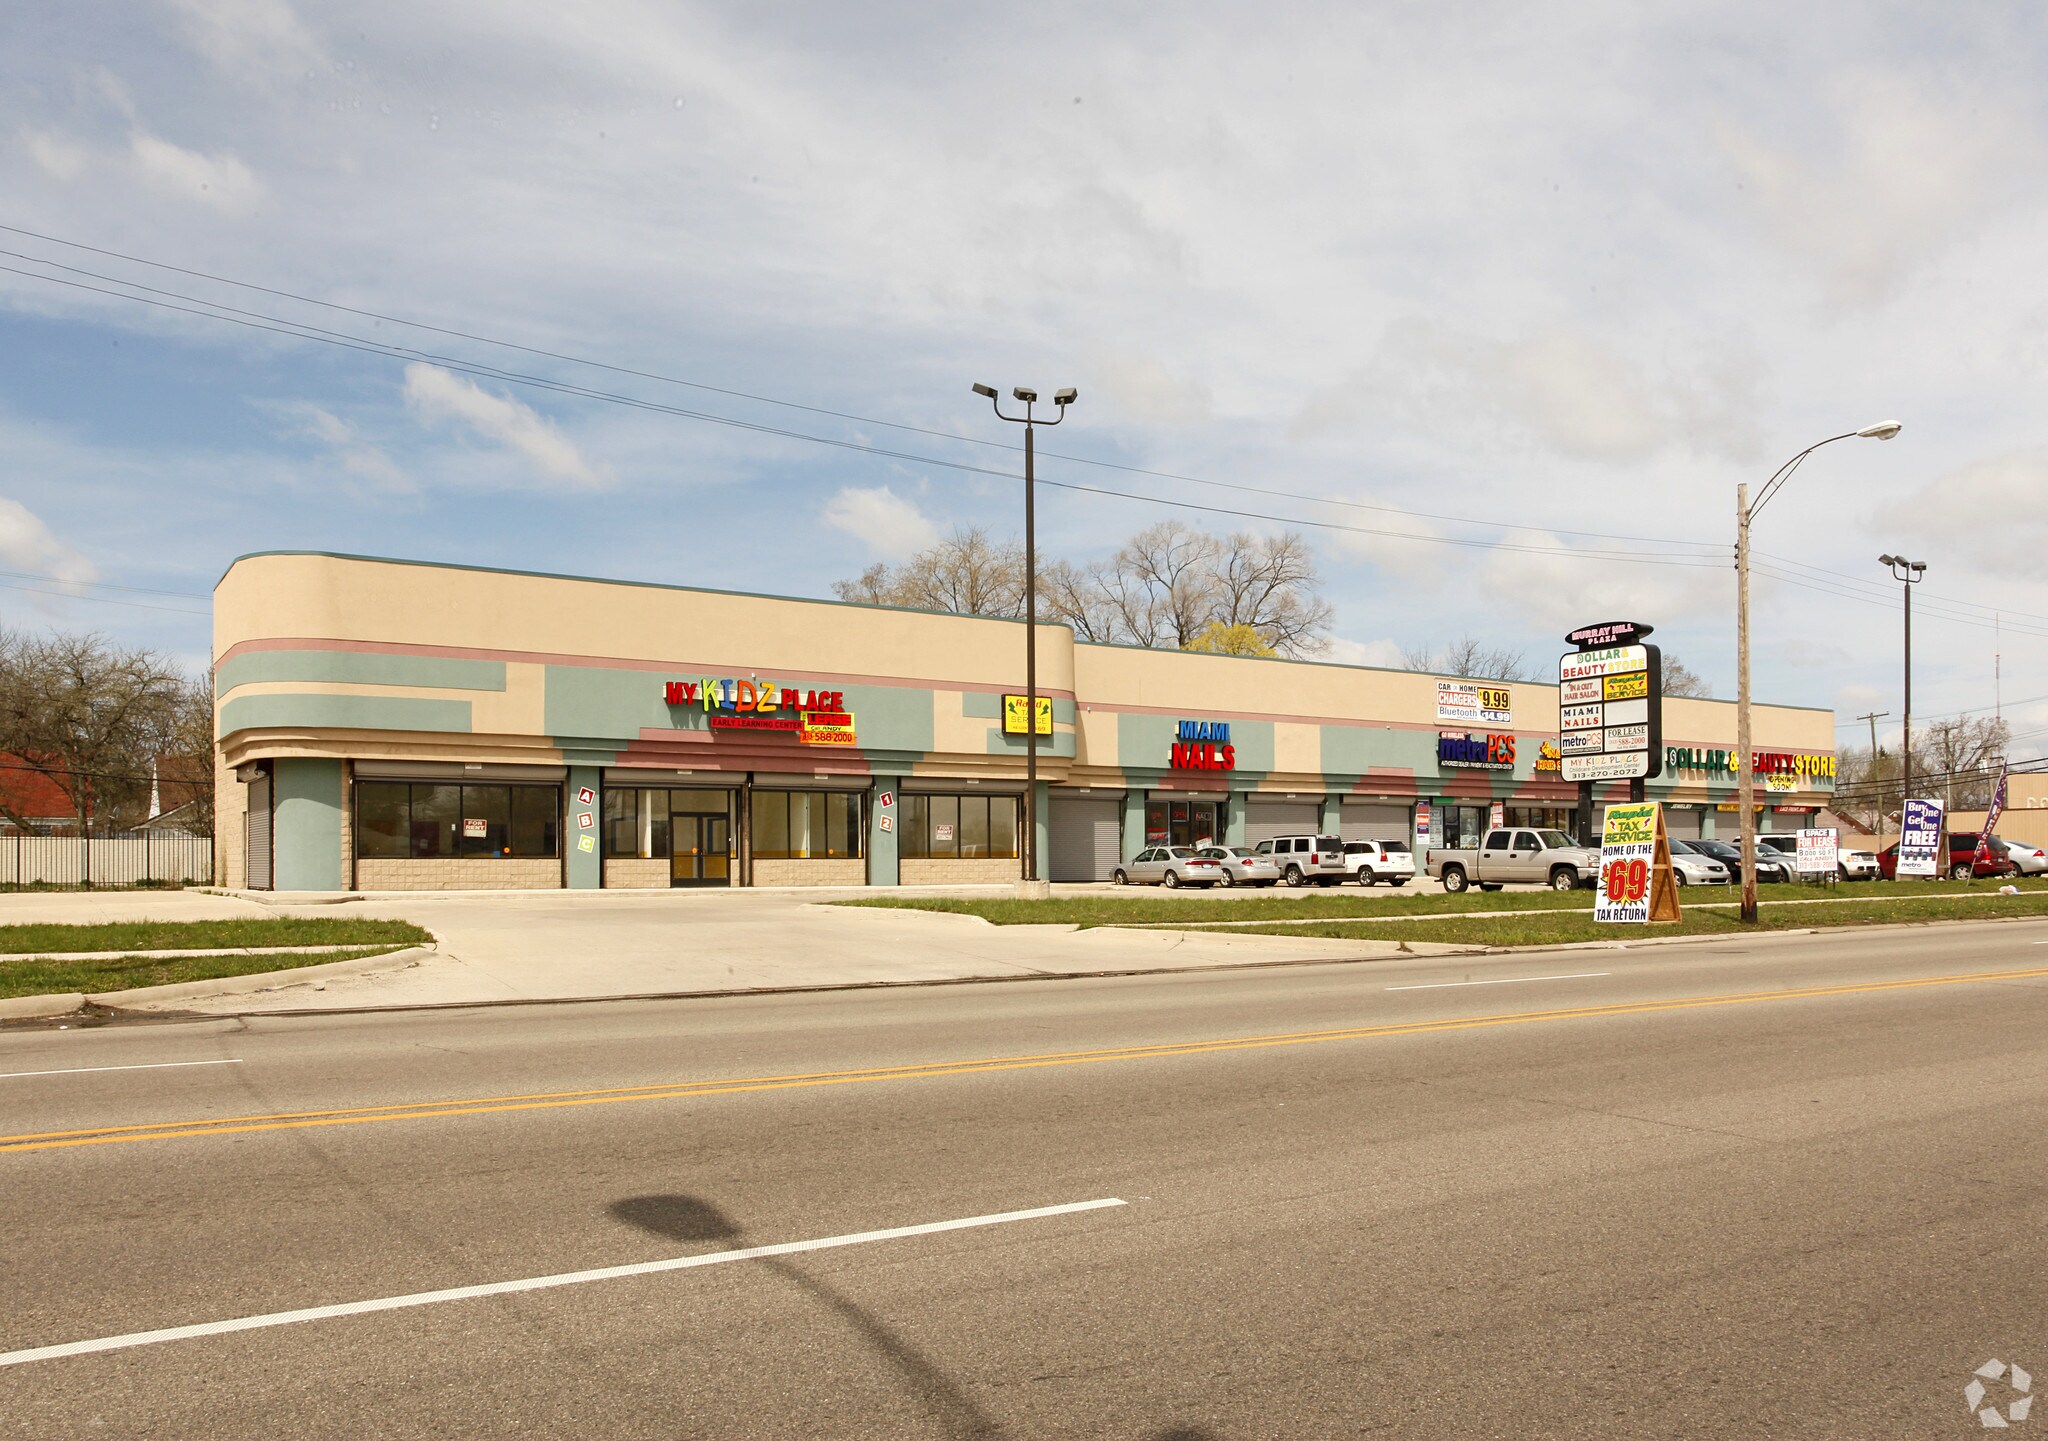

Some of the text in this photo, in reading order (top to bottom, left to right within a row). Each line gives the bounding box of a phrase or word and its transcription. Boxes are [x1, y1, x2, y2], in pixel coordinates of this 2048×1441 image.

[1572, 623, 1634, 640] MURRAY HILL
[1587, 635, 1617, 645] PLAZA
[1577, 647, 1629, 664] DOLLAR &
[1563, 658, 1645, 678] BEAUTY STORE
[1459, 685, 1476, 693] HOME
[1581, 682, 1593, 690] OUT
[666, 678, 845, 713] MY KIDZ PLACE
[1439, 692, 1477, 707] CHARGERS
[1564, 690, 1599, 700] HAIR SALON
[1607, 689, 1647, 699] SERVICE
[1016, 699, 1042, 708] Rad
[1440, 707, 1477, 717] Bluetooth
[1563, 706, 1599, 717] MIAMI
[712, 719, 803, 730] EARLY LEARNING CENTER
[808, 714, 851, 726] LEASE
[1011, 716, 1047, 724] SERCE
[1564, 717, 1599, 727] NAILS
[1179, 720, 1230, 741] MIAMI
[1608, 726, 1646, 737] FOR LEASE
[1563, 732, 1602, 748] metroPCS
[1439, 733, 1517, 763] metroPCS
[1172, 743, 1236, 770] NAILS
[1570, 758, 1583, 767] MY
[1586, 757, 1606, 766] KIDZ
[1610, 754, 1639, 763] PLACE
[1667, 747, 1837, 777] DOLLAR & EAUTY STORE
[1537, 760, 1556, 770] HAIR
[1572, 769, 1638, 779] 313-270-2072
[1769, 776, 1795, 784] OPENING
[580, 791, 590, 802] A
[1607, 806, 1655, 821] Rapid
[1908, 802, 1939, 817] Buy One
[581, 815, 591, 826] B
[1908, 815, 1937, 830] Get One
[1618, 821, 1640, 832] TAX
[1604, 830, 1652, 843] SERVICE
[1904, 831, 1937, 845] FREE
[582, 839, 591, 848] C
[1798, 837, 1836, 848] FOR LEASE
[1603, 844, 1652, 856] HOME OF THE
[1597, 908, 1647, 920] TAX RETURN
